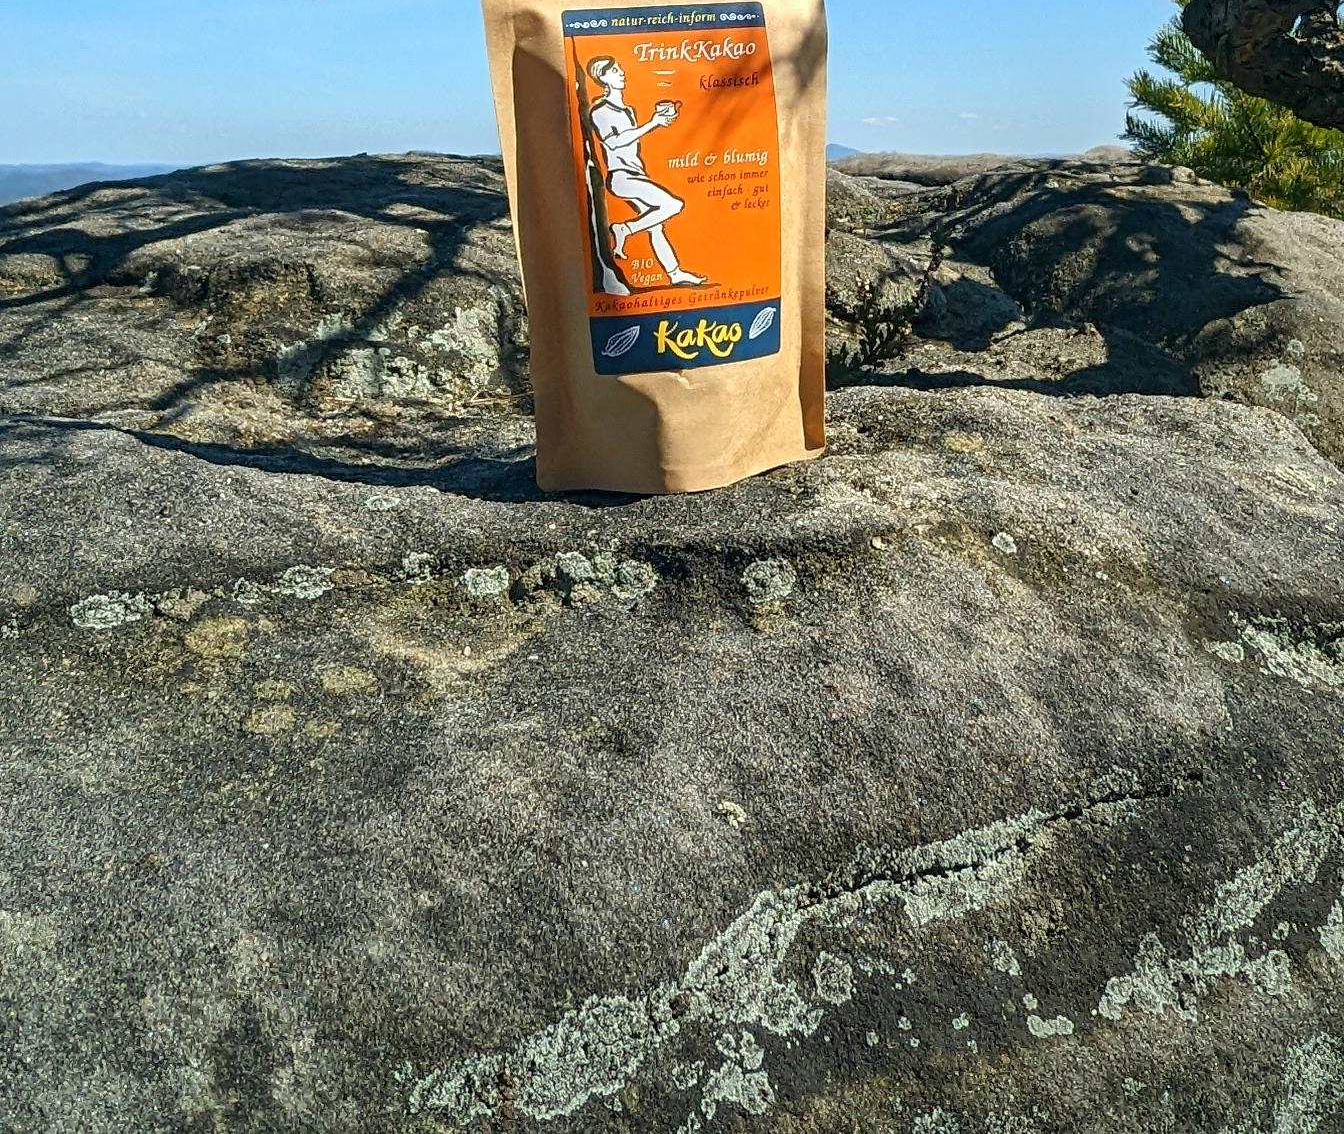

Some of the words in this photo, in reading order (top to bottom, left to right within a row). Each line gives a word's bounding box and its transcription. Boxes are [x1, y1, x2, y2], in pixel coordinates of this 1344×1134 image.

[633, 36, 756, 63] TrinkKakao
[699, 72, 760, 90] klassisch
[668, 152, 699, 168] mild
[704, 153, 717, 166] &
[723, 148, 768, 166] blumig
[687, 173, 705, 184] wie
[708, 170, 736, 183] schon
[740, 169, 768, 180] immer
[707, 184, 743, 199] einfach
[752, 184, 769, 196] gut
[744, 198, 770, 210] lecker
[631, 257, 654, 270] BIO
[631, 270, 663, 284] Vegan
[595, 296, 683, 313] Kakaohaltiges
[688, 285, 770, 304] Getränkepulver
